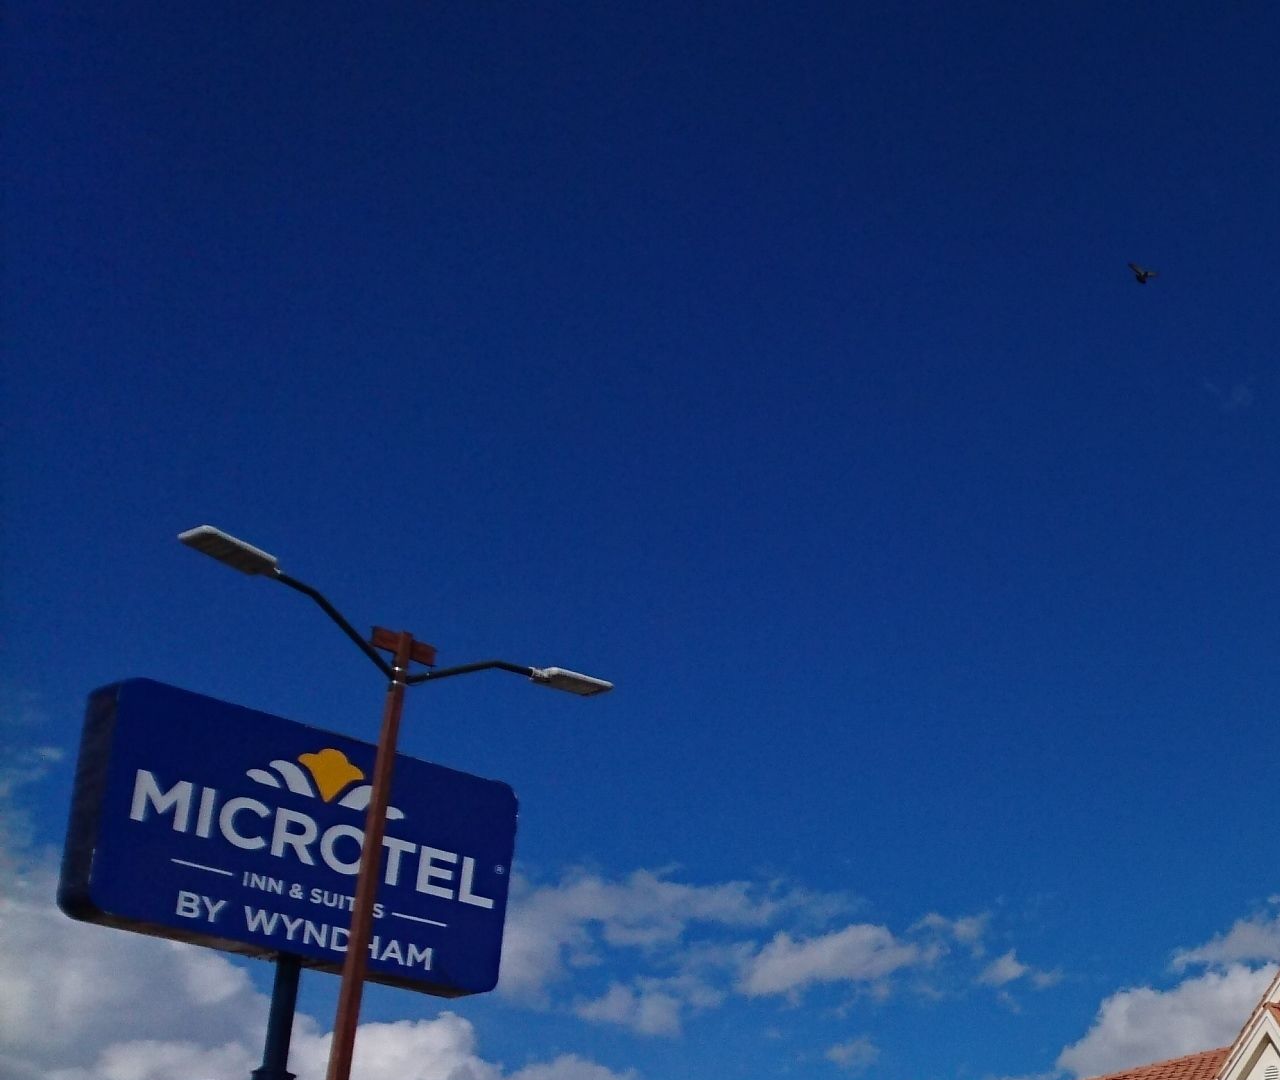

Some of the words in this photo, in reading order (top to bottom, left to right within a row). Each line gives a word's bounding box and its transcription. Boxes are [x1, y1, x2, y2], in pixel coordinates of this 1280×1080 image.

[129, 768, 494, 909] MICROTEL
[175, 890, 227, 923] BY
[242, 870, 283, 895] INN
[288, 883, 304, 900] &
[309, 888, 386, 919] SUITS
